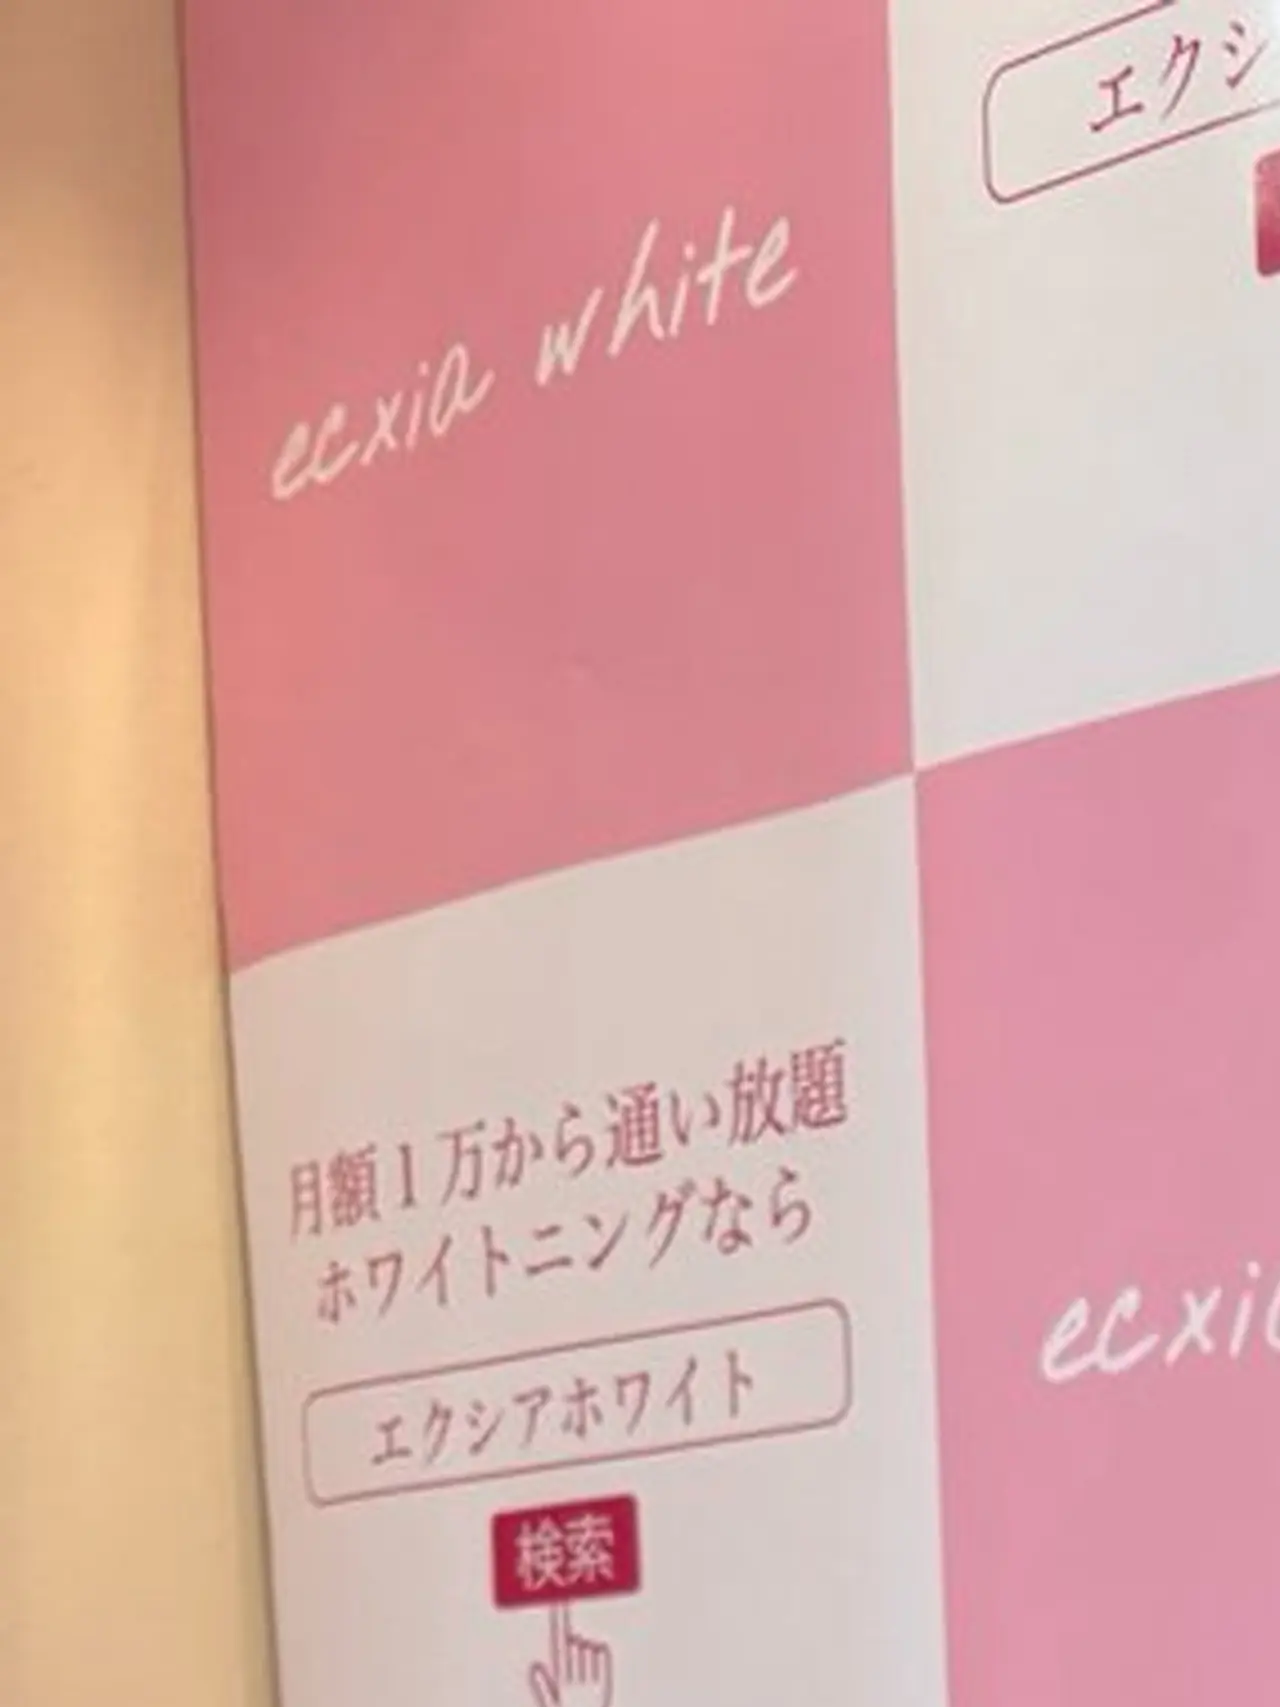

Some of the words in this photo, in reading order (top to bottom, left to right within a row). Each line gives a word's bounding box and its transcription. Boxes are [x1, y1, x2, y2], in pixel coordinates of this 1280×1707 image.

[272, 344, 494, 500] ecxia
[535, 206, 799, 386] white
[315, 1168, 812, 1325] ホワイトニングなら
[371, 1348, 755, 1468] エクシアホワイト
[513, 1513, 616, 1593] 検索
